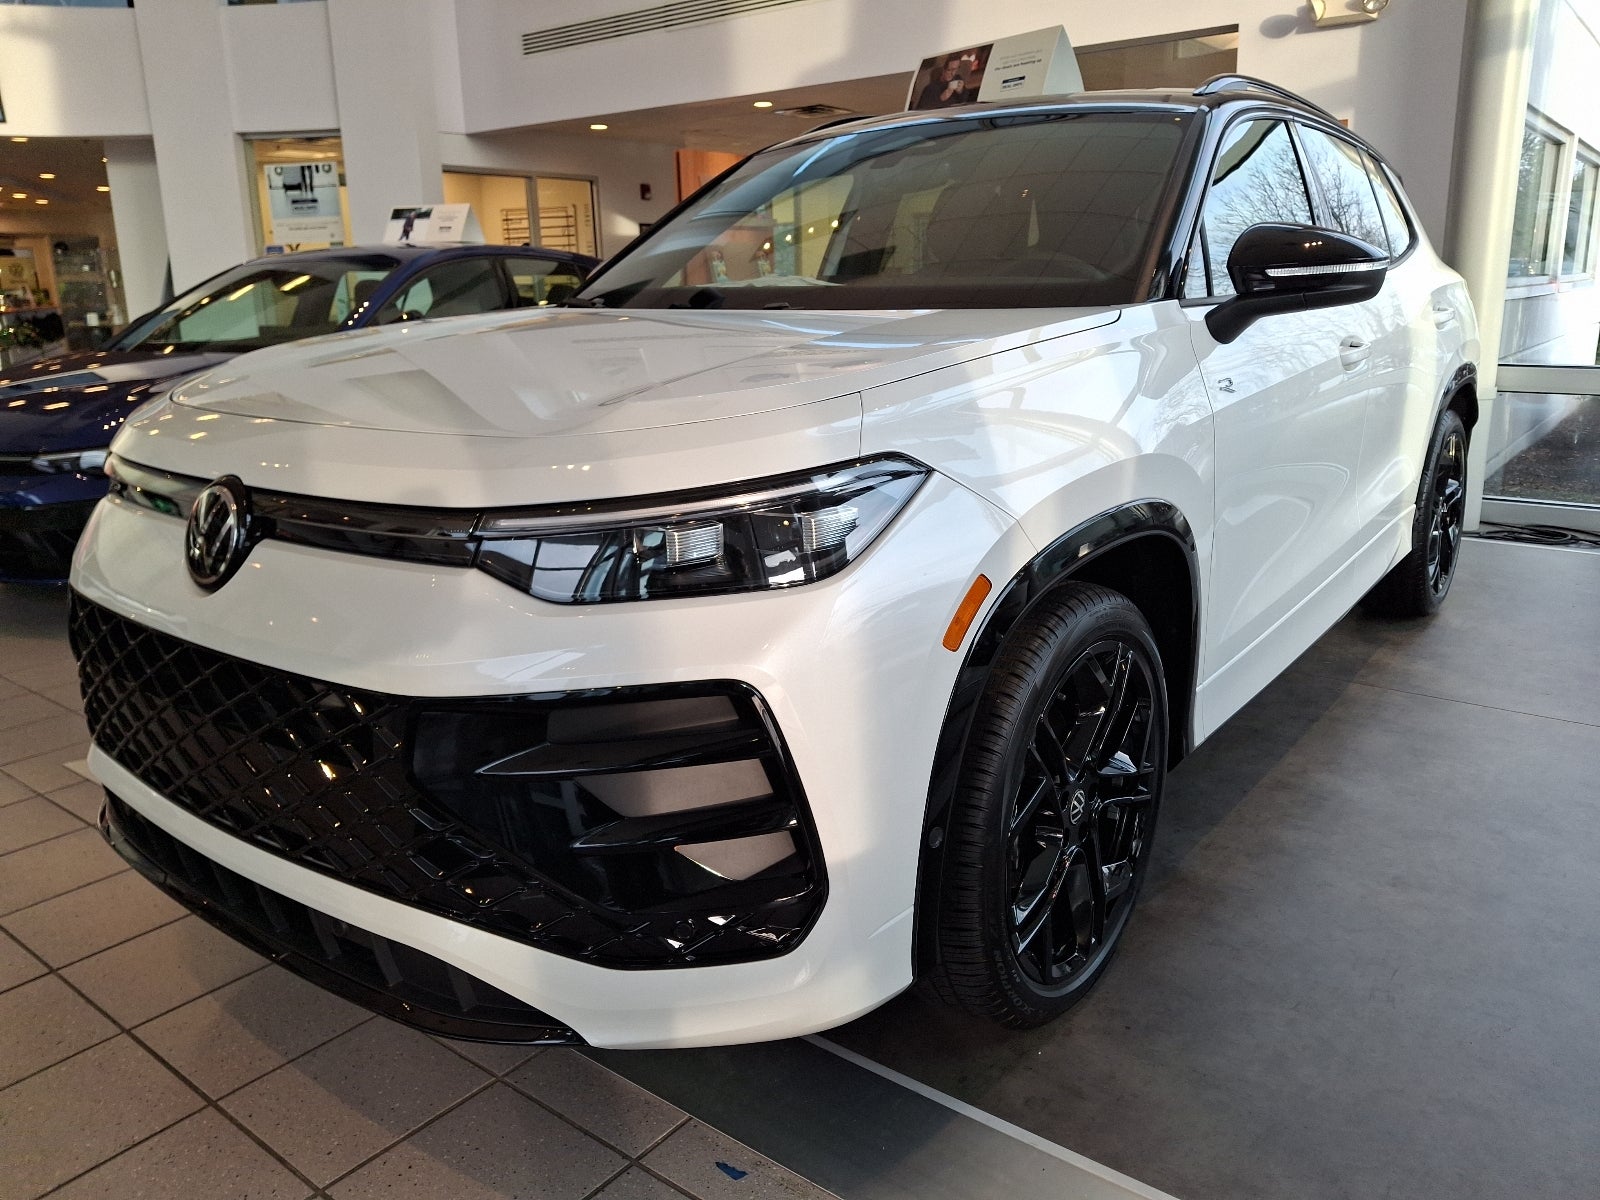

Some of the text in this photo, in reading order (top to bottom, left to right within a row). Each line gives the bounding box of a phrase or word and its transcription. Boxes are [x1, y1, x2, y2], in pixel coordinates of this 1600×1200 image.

[185, 484, 238, 586] VW
[1070, 789, 1086, 825] VW
[993, 949, 1035, 1016] SCORPION
